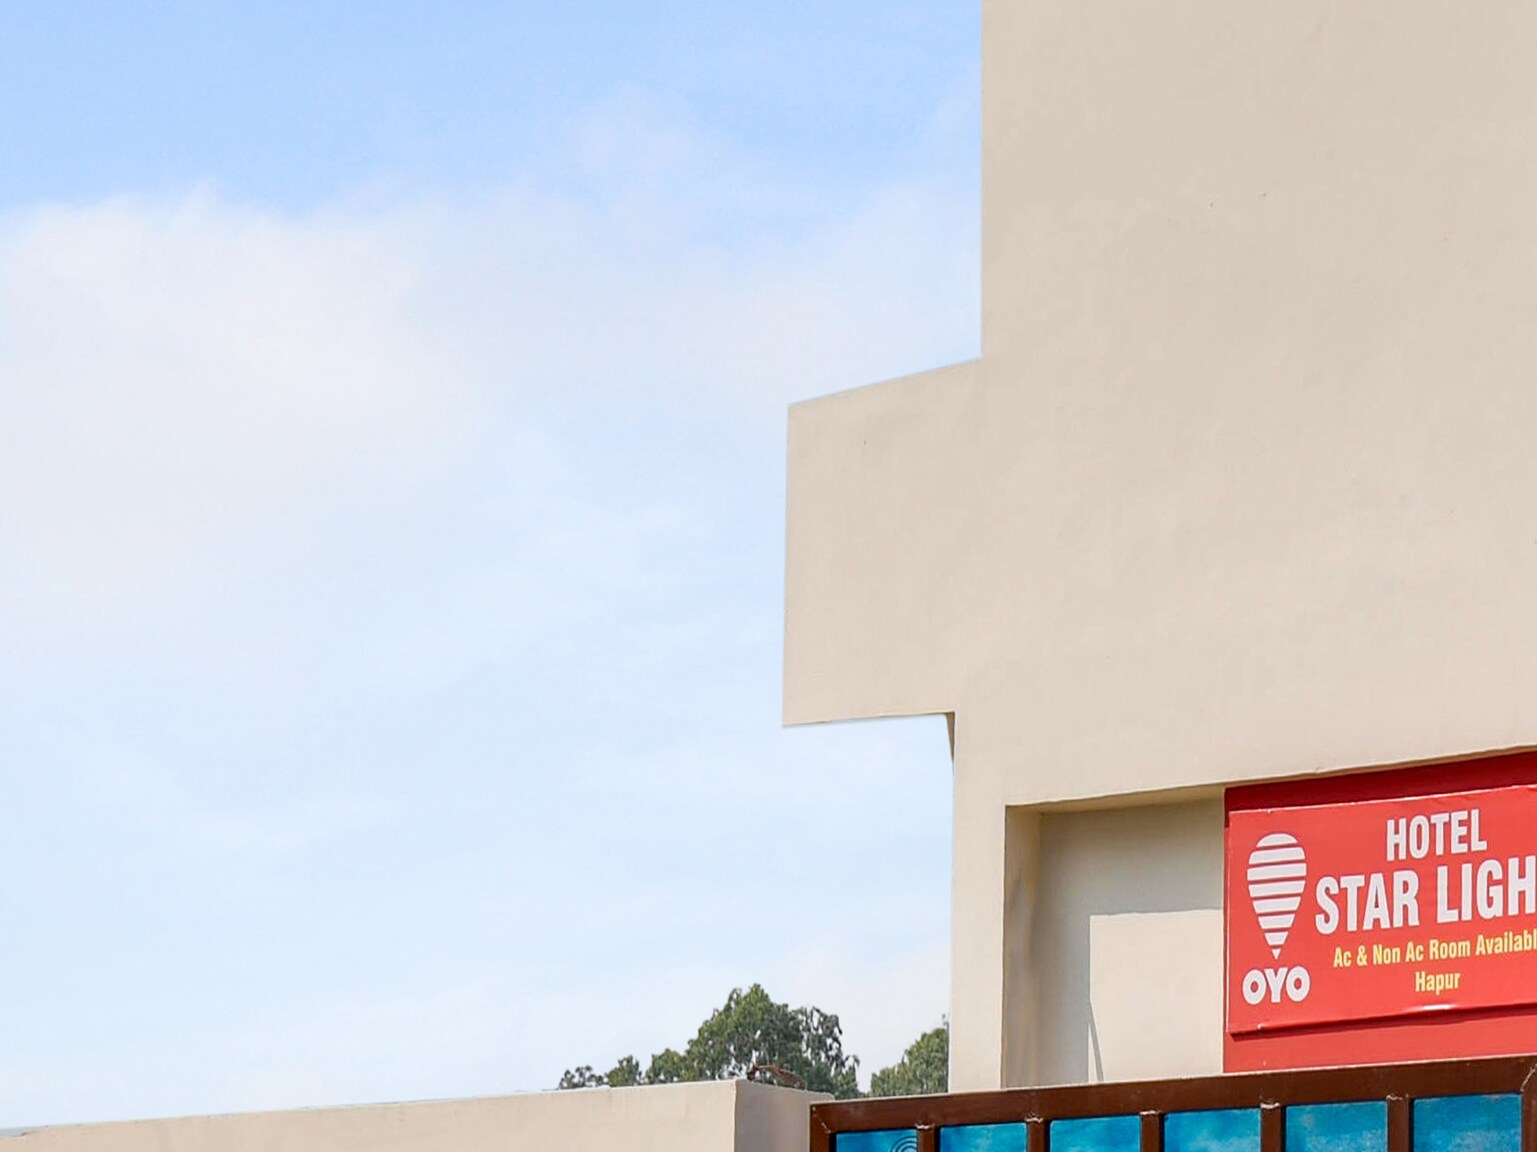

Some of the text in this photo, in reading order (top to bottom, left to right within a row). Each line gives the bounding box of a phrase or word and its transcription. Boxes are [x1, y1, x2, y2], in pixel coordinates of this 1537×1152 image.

[1387, 809, 1487, 861] HOTEL
[1316, 871, 1419, 934] STAR
[1334, 947, 1351, 967] Ac
[1357, 946, 1367, 966] &
[1373, 944, 1400, 964] Non
[1406, 942, 1423, 962] Ac
[1430, 940, 1470, 959] Room
[1243, 966, 1310, 1004] OYO
[1416, 971, 1460, 995] Hapur
